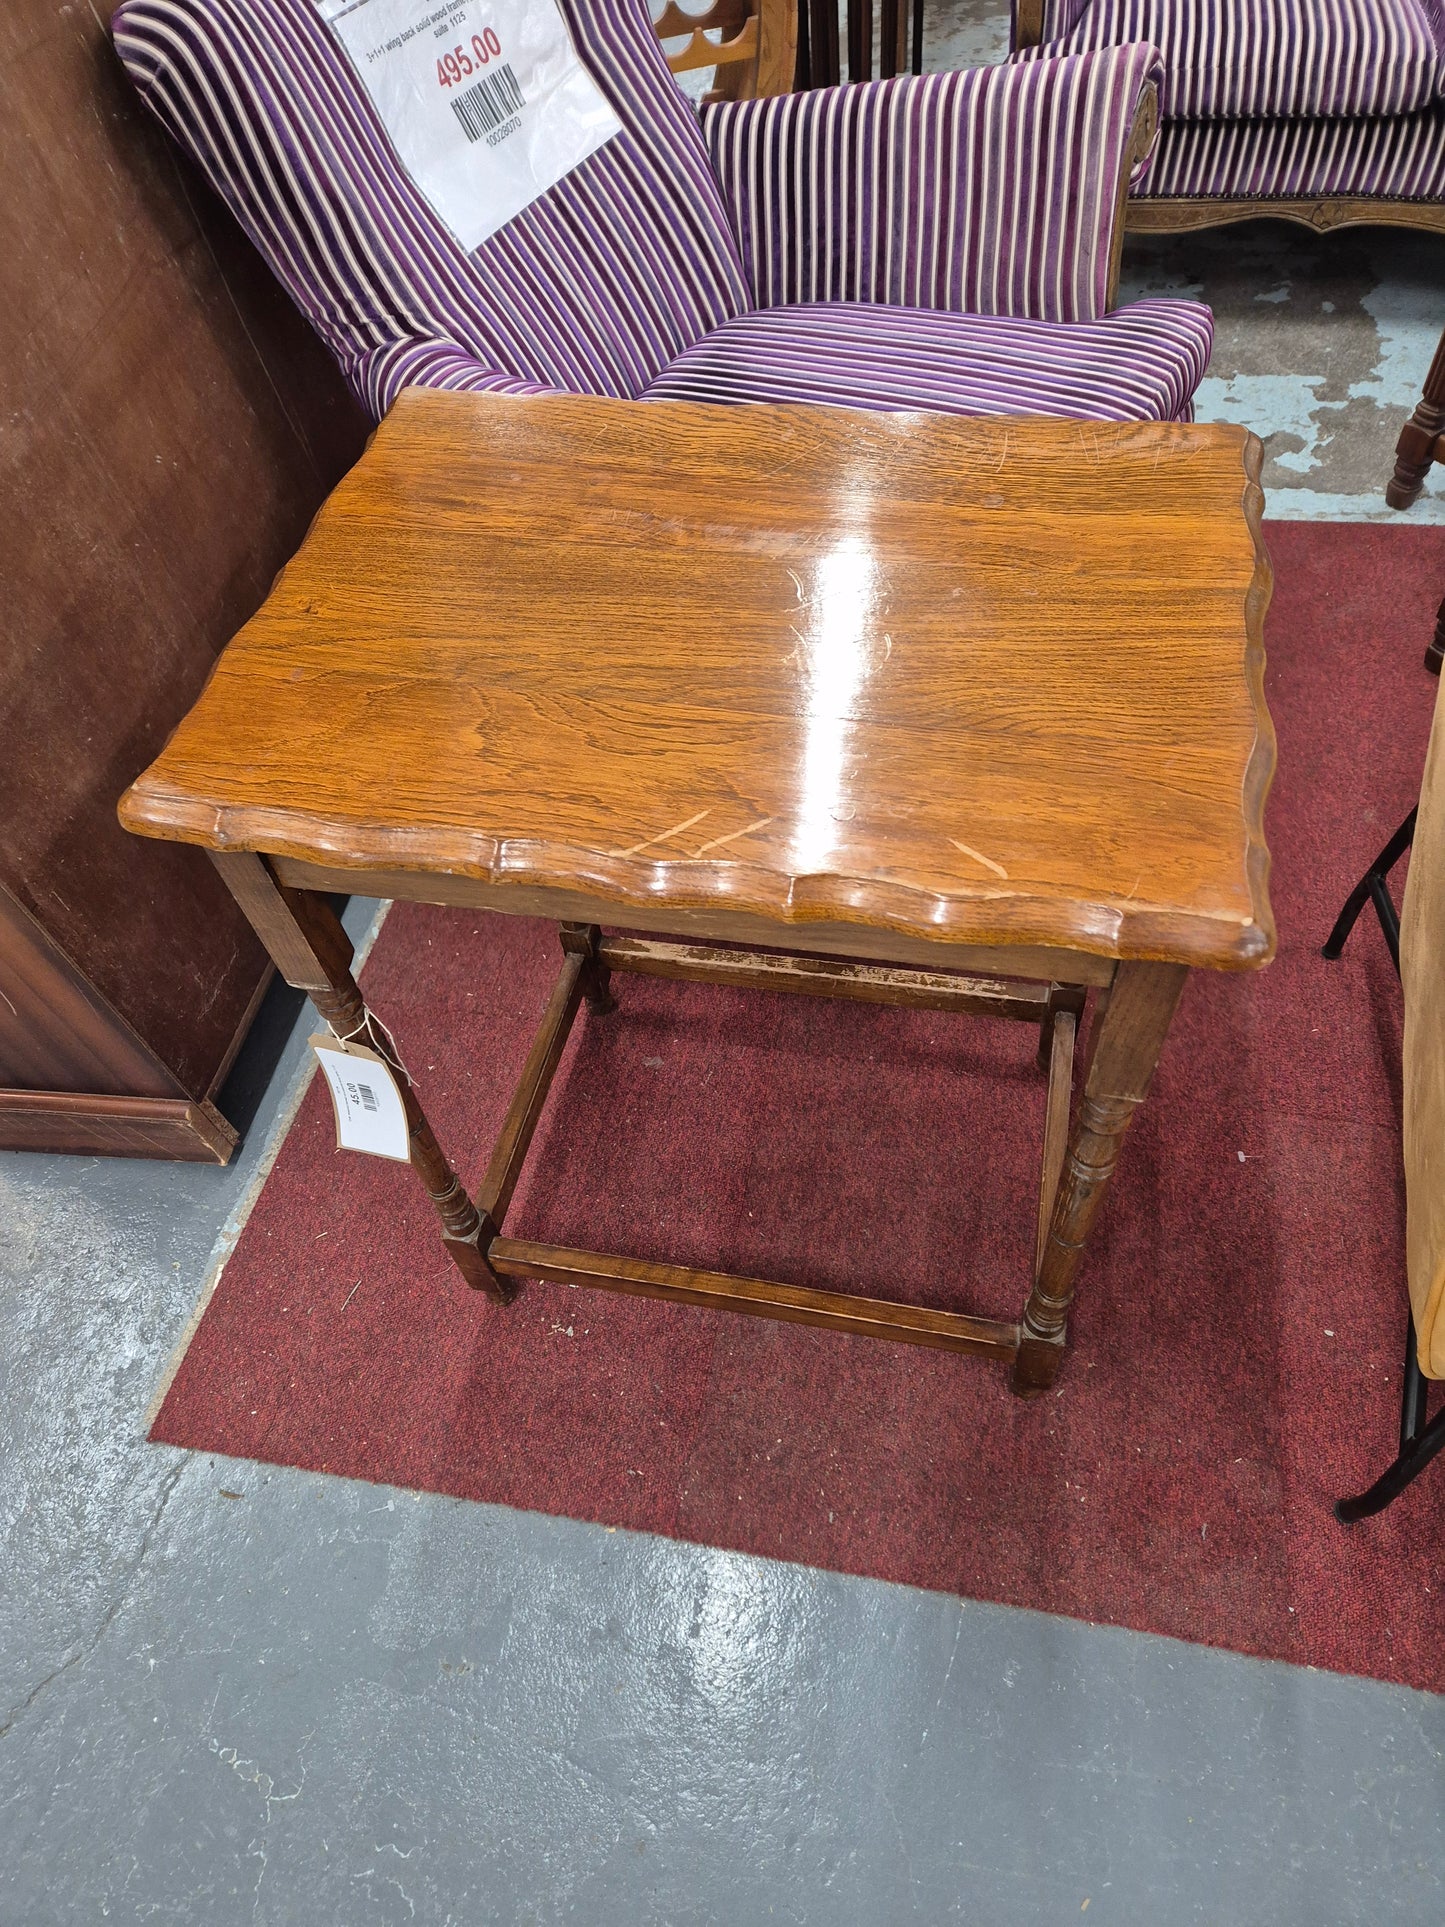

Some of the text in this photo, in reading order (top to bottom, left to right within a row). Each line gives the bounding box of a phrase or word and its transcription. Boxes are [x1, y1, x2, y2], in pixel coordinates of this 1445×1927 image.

[366, 44, 385, 63] 3+1+1
[385, 37, 402, 51] wing
[400, 26, 416, 42] back
[415, 16, 431, 33] solid
[430, 5, 448, 23] wood
[433, 11, 466, 38] suite 1125
[436, 27, 502, 88] 495.00
[486, 116, 522, 148] 10028070
[346, 1082, 360, 1105] 45.00
